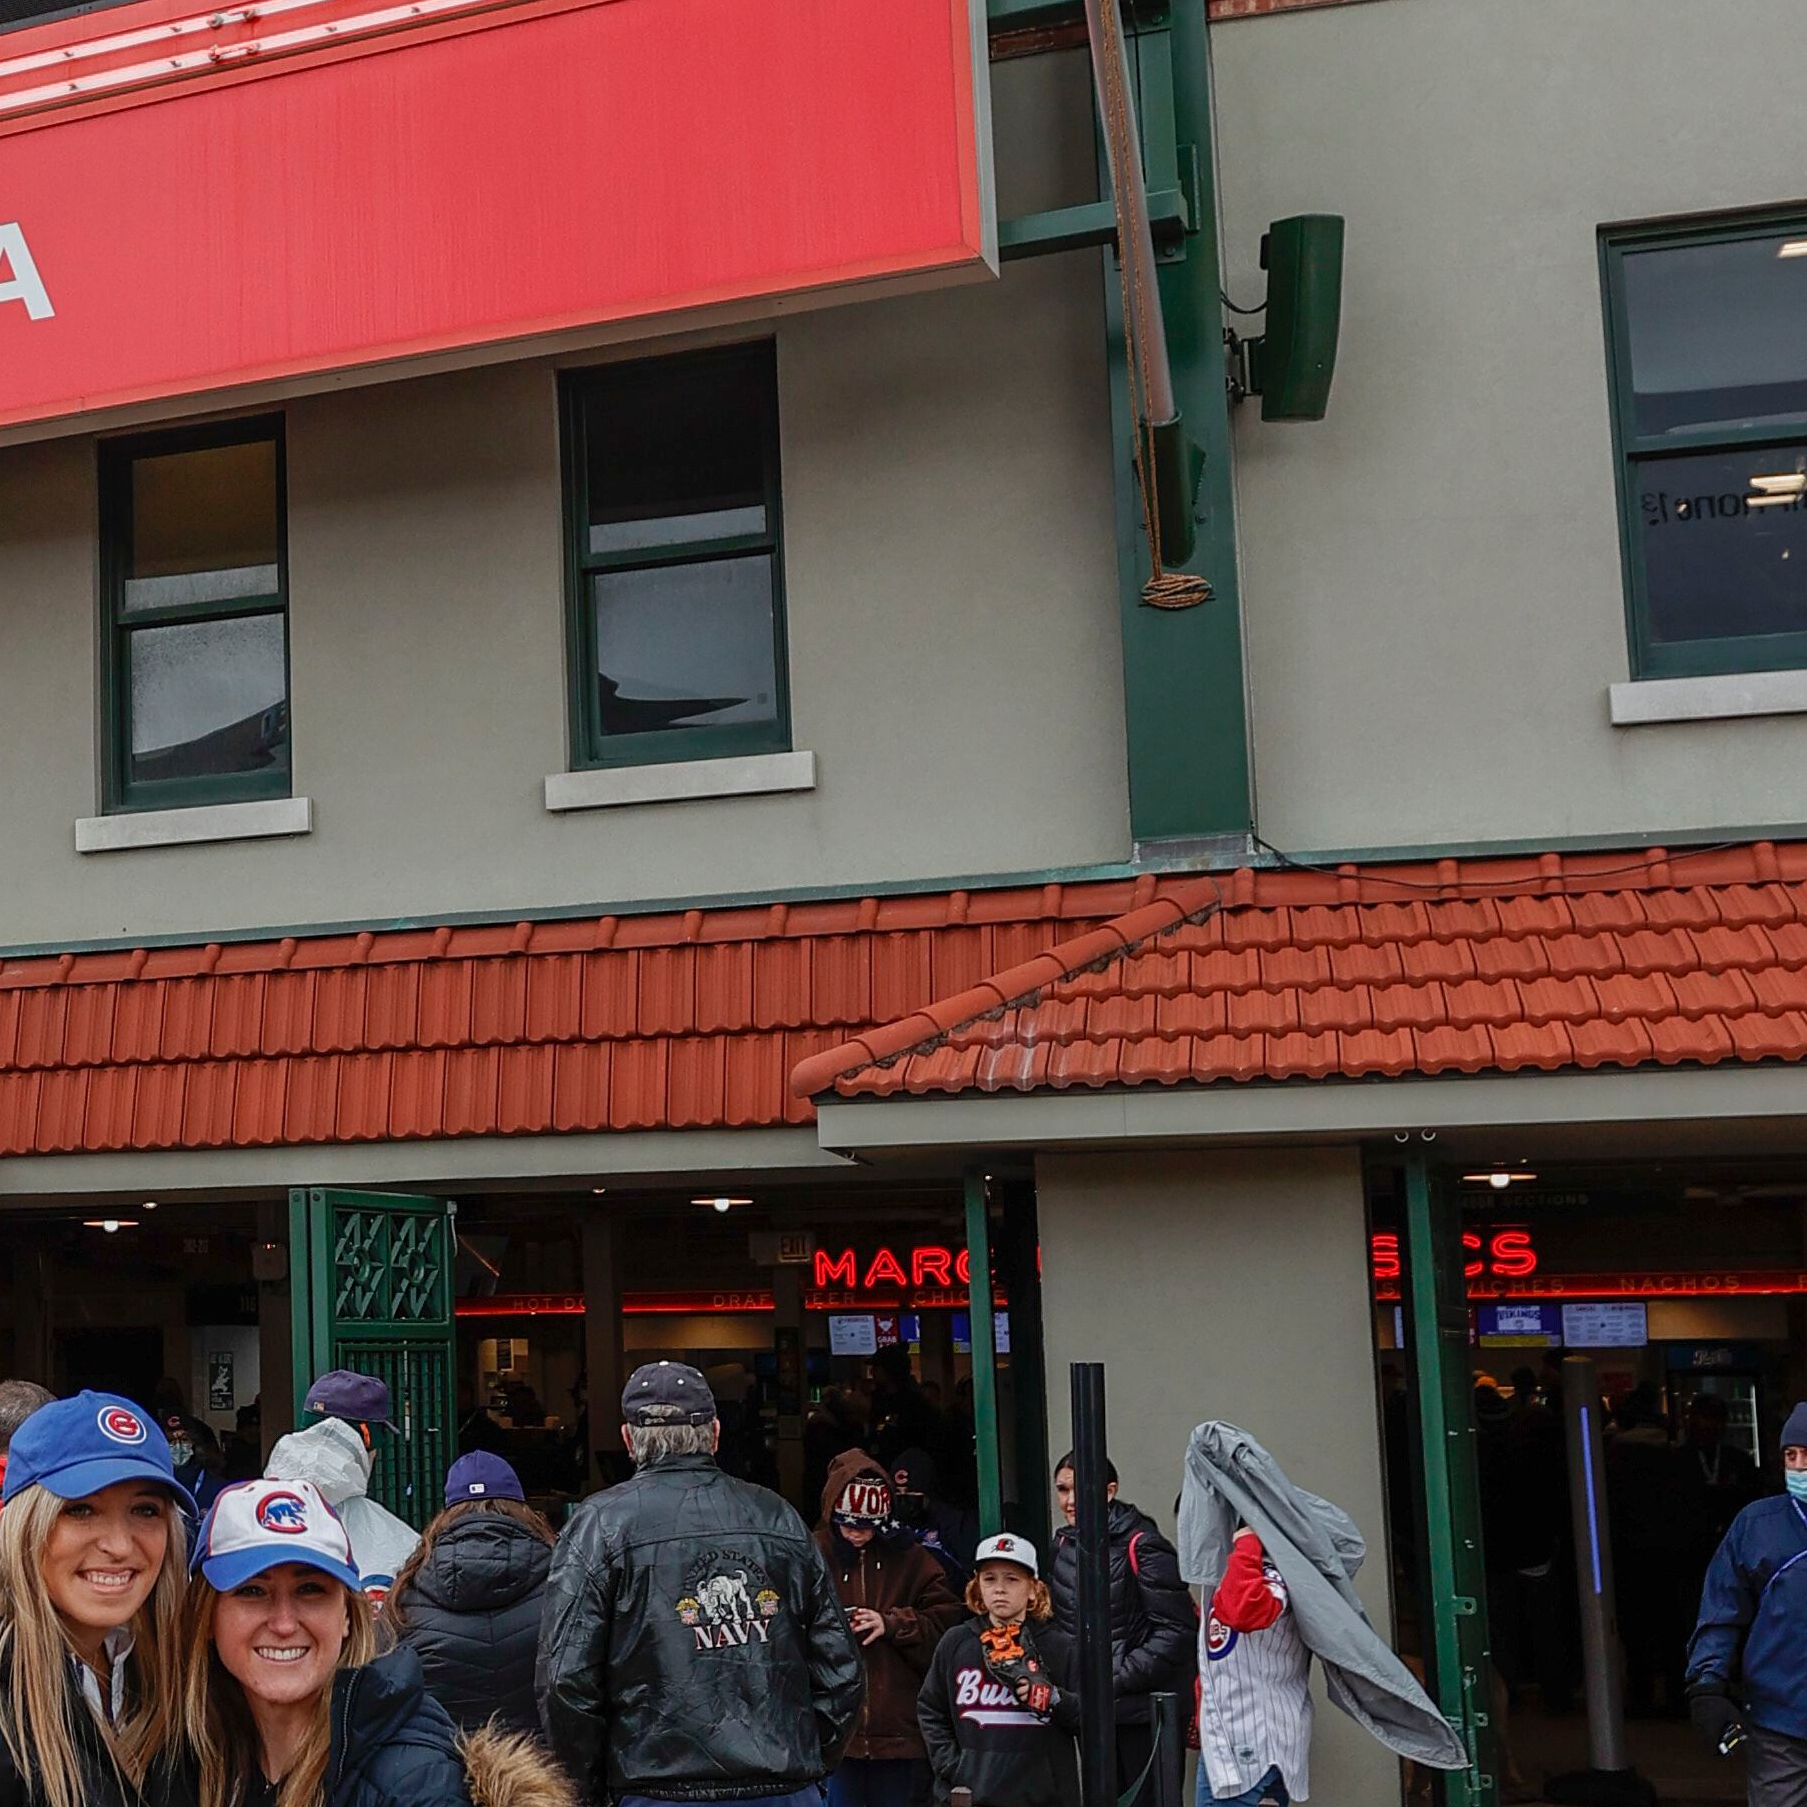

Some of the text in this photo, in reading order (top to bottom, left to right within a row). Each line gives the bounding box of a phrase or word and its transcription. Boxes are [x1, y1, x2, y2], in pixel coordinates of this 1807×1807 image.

[1620, 1274, 1740, 1292] NACHOS
[513, 1298, 553, 1311] HOT
[804, 1293, 858, 1307] EER
[694, 1618, 771, 1650] NAVY
